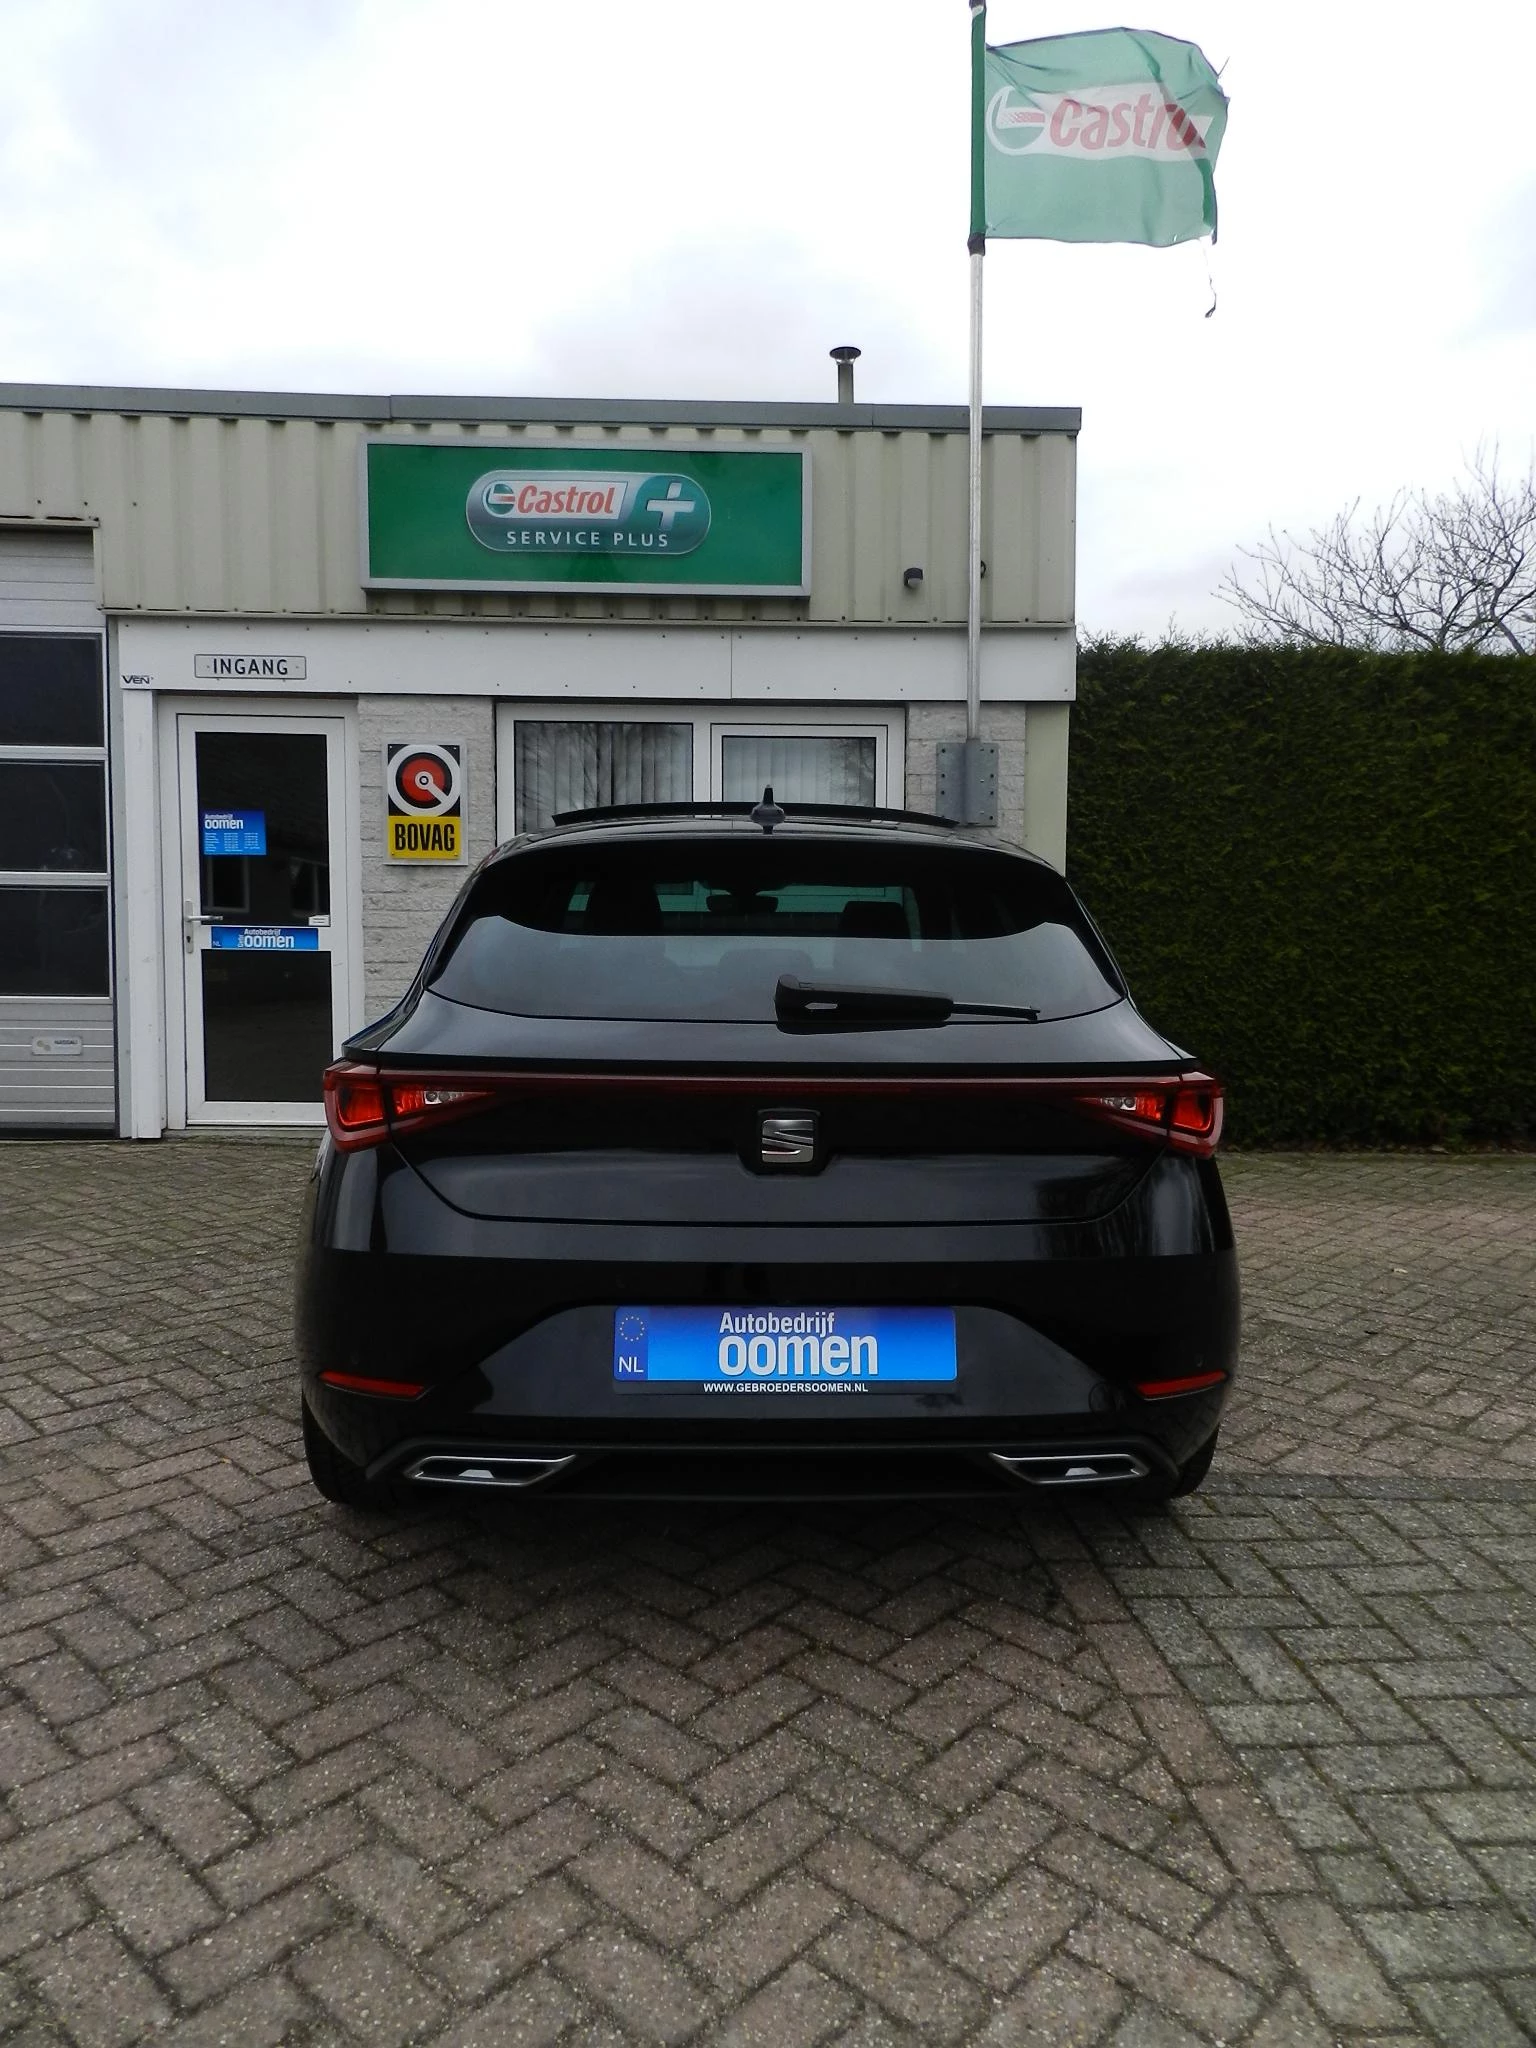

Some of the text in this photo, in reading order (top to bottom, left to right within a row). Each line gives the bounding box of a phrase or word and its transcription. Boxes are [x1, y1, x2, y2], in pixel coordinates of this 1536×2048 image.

[517, 485, 614, 514] Castrol
[506, 531, 668, 547] SERVICE PLUS
[213, 658, 288, 675] INGANG
[204, 819, 244, 829] oomen
[394, 823, 455, 852] BOVAG
[244, 935, 295, 948] oomen
[719, 1311, 835, 1338] Autobedrijf
[618, 1356, 644, 1373] NL
[718, 1335, 879, 1378] oomen
[703, 1382, 869, 1393] WWW.GEBROEDERSOOMEN.NL
